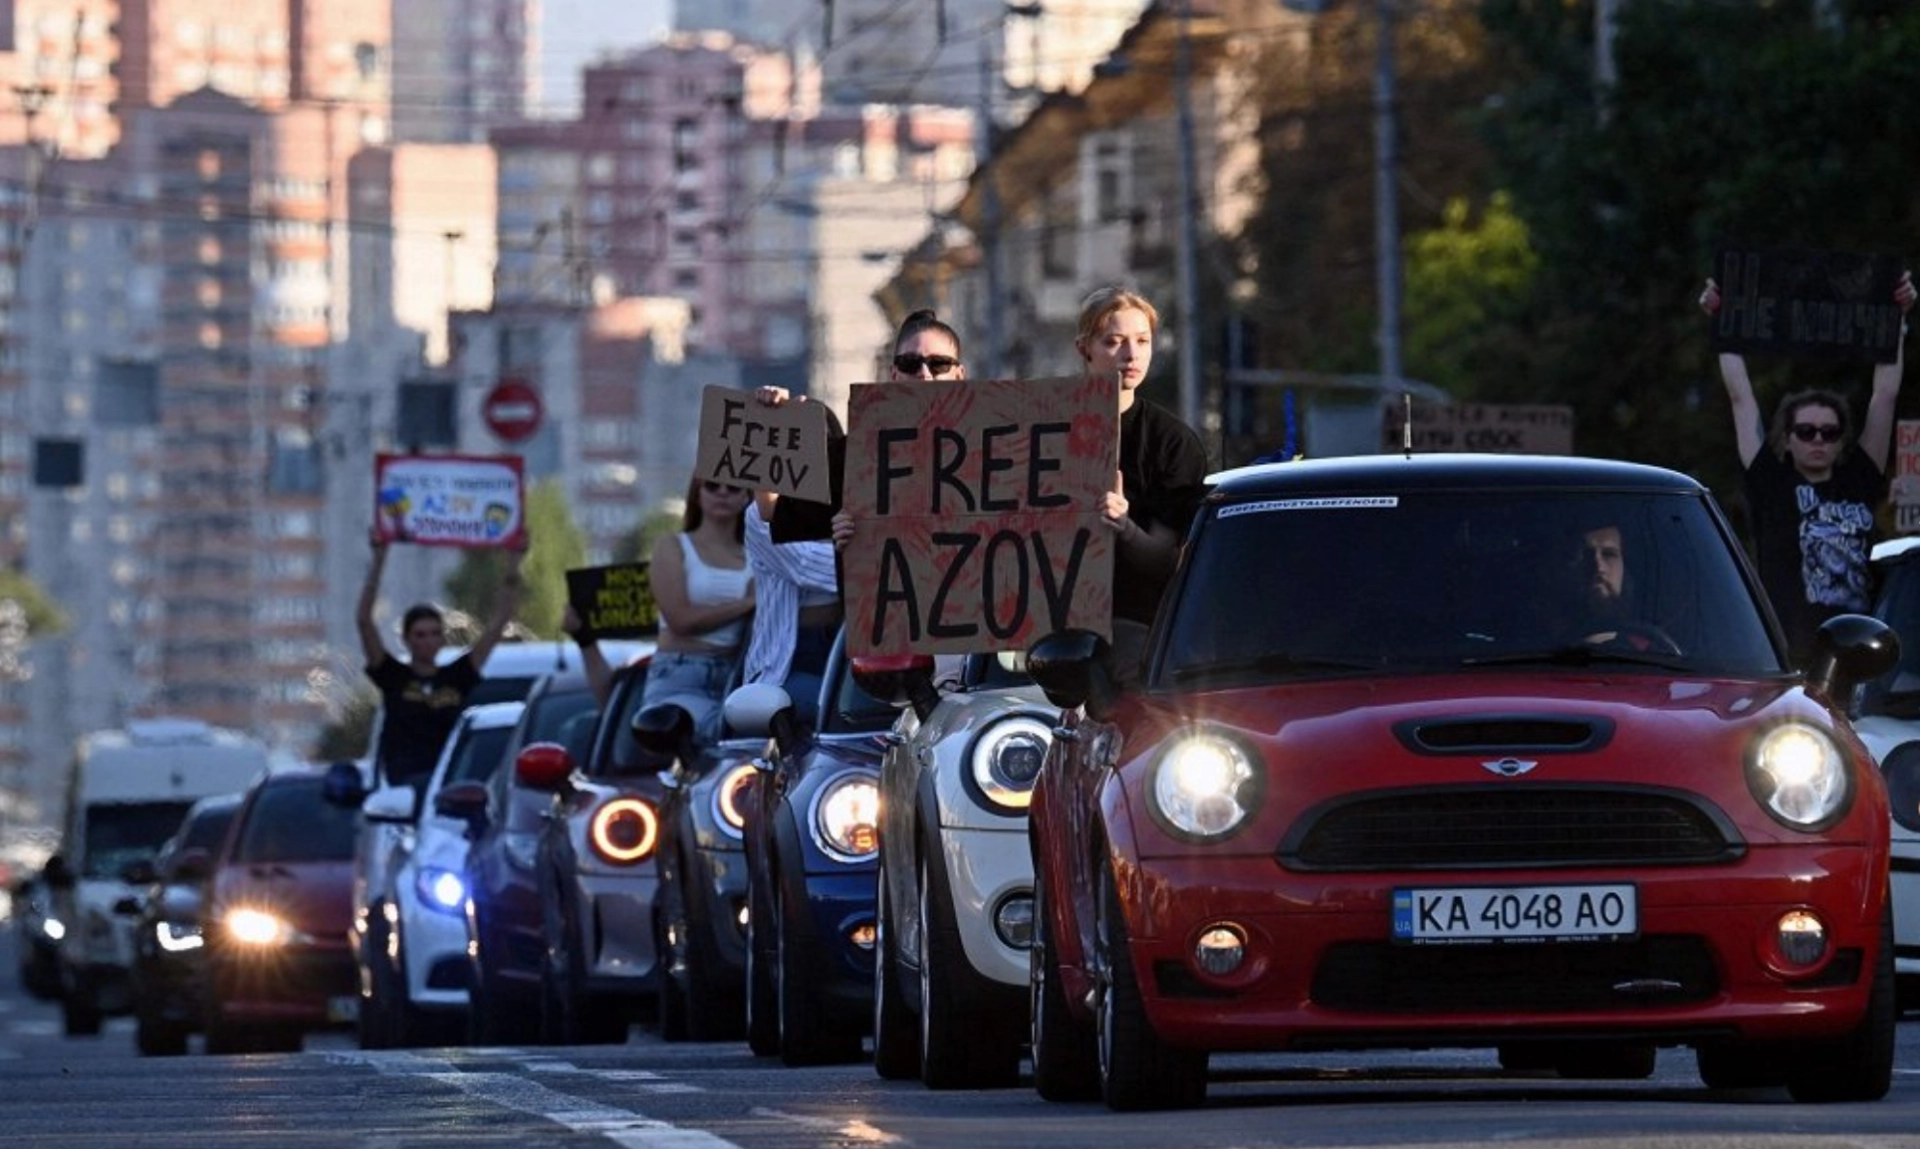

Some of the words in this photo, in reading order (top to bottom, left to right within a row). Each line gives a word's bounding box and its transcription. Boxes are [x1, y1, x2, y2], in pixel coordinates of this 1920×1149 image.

[713, 444, 809, 492] AZOV
[876, 422, 1072, 515] FREE
[871, 528, 1092, 647] AZOV
[1418, 895, 1470, 932] KA
[1480, 893, 1563, 930] 4048
[1575, 891, 1625, 929] AO
